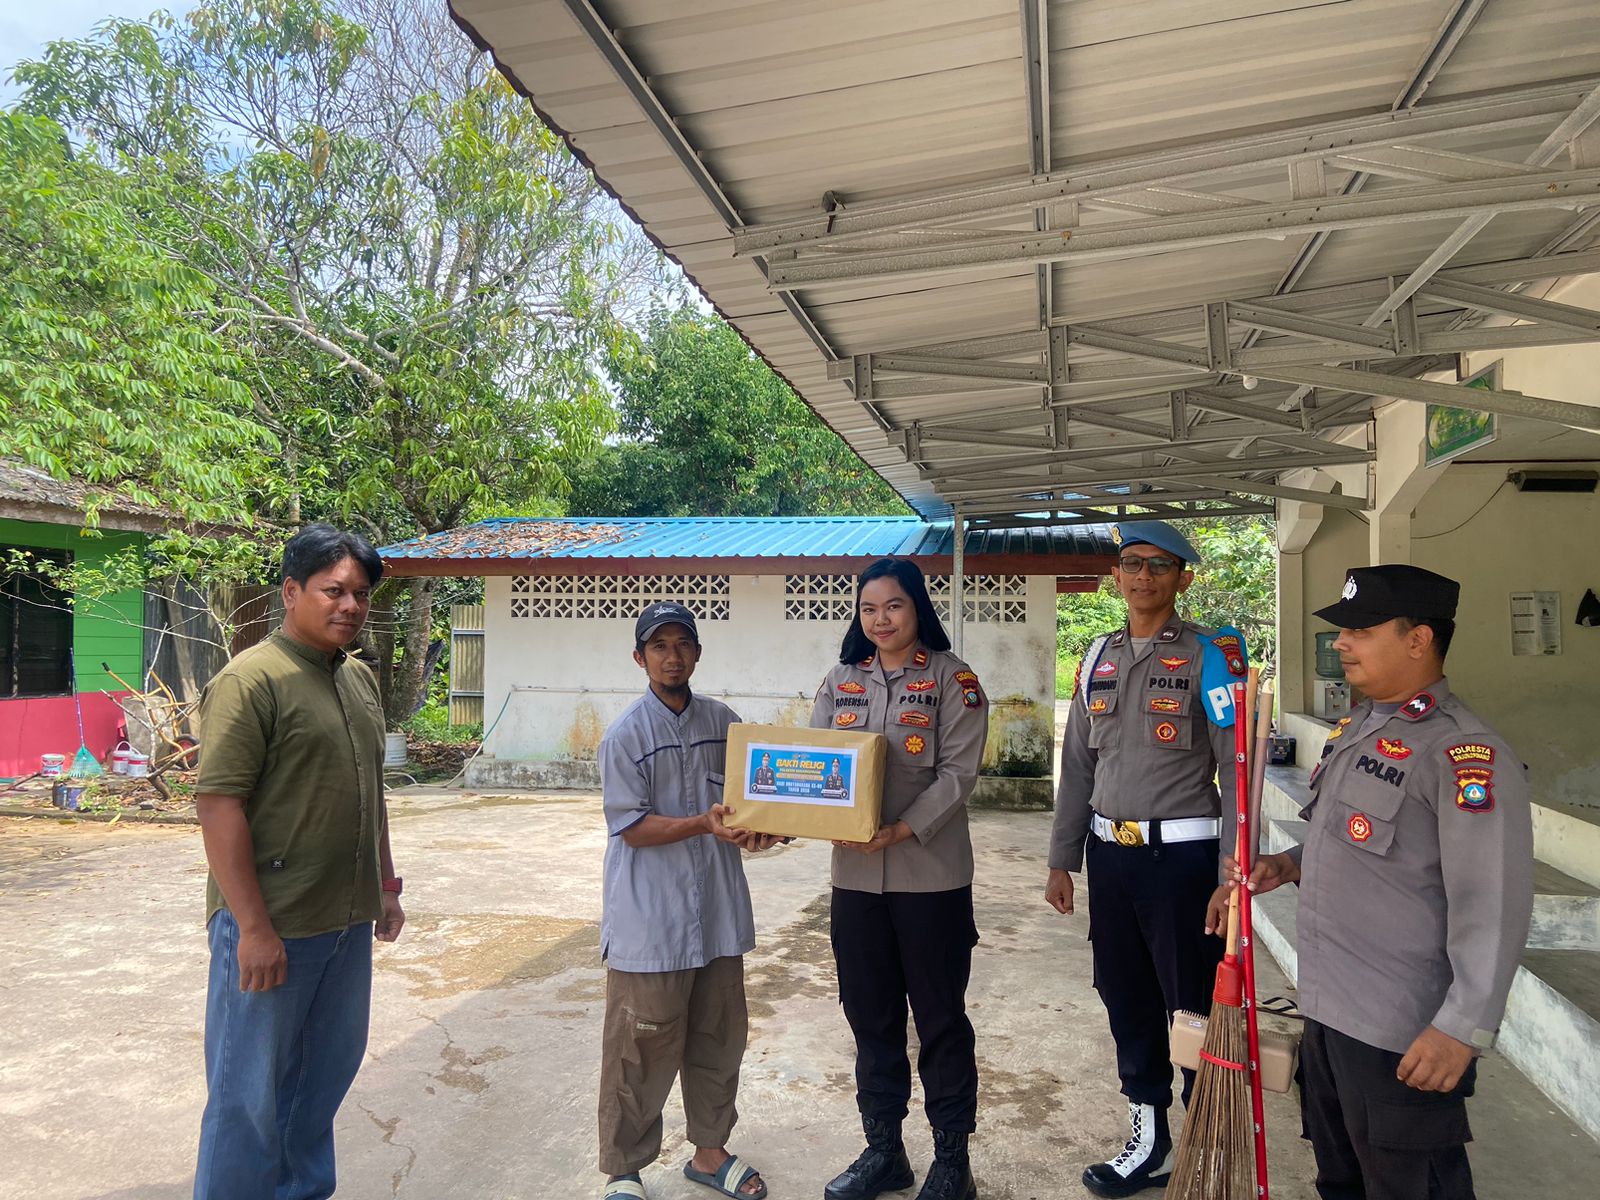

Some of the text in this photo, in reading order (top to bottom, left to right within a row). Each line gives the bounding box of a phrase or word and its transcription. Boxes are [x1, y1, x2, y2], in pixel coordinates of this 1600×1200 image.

[1149, 677, 1190, 690] POLRI
[899, 694, 937, 706] POLRI
[1449, 745, 1491, 757] POLRESTA
[776, 759, 825, 769] BAKTI RELIGI
[1355, 755, 1405, 787] POLRI
